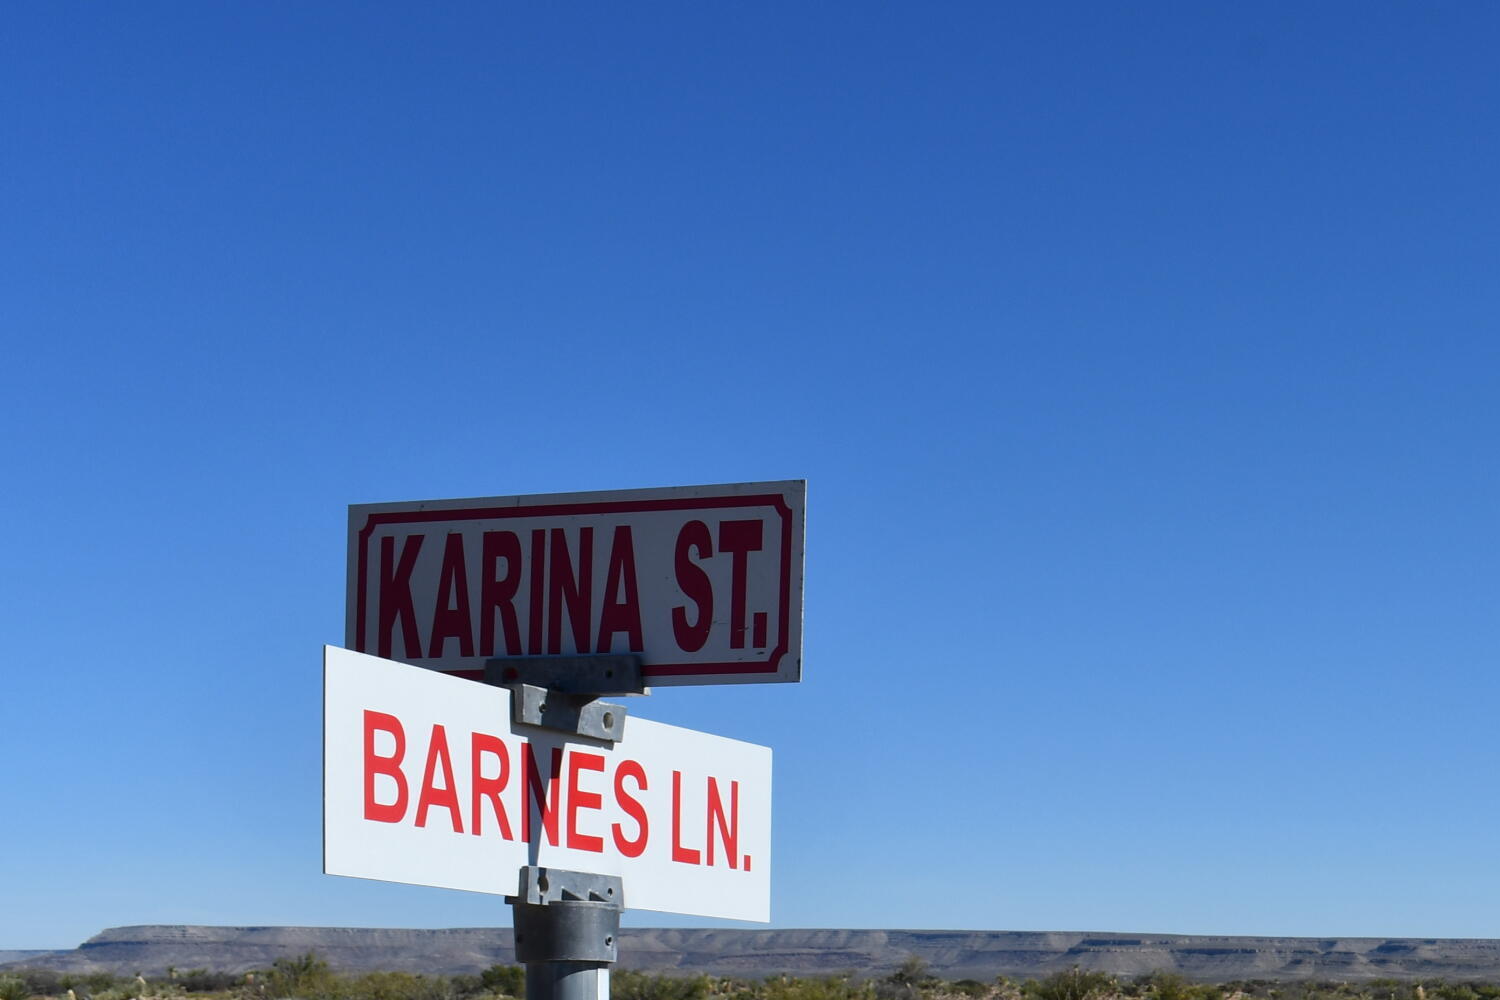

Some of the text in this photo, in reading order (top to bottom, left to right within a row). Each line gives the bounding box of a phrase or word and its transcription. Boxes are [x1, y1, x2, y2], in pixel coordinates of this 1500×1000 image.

[378, 519, 768, 659] KARINA ST.
[363, 709, 752, 872] BARNES LN.
